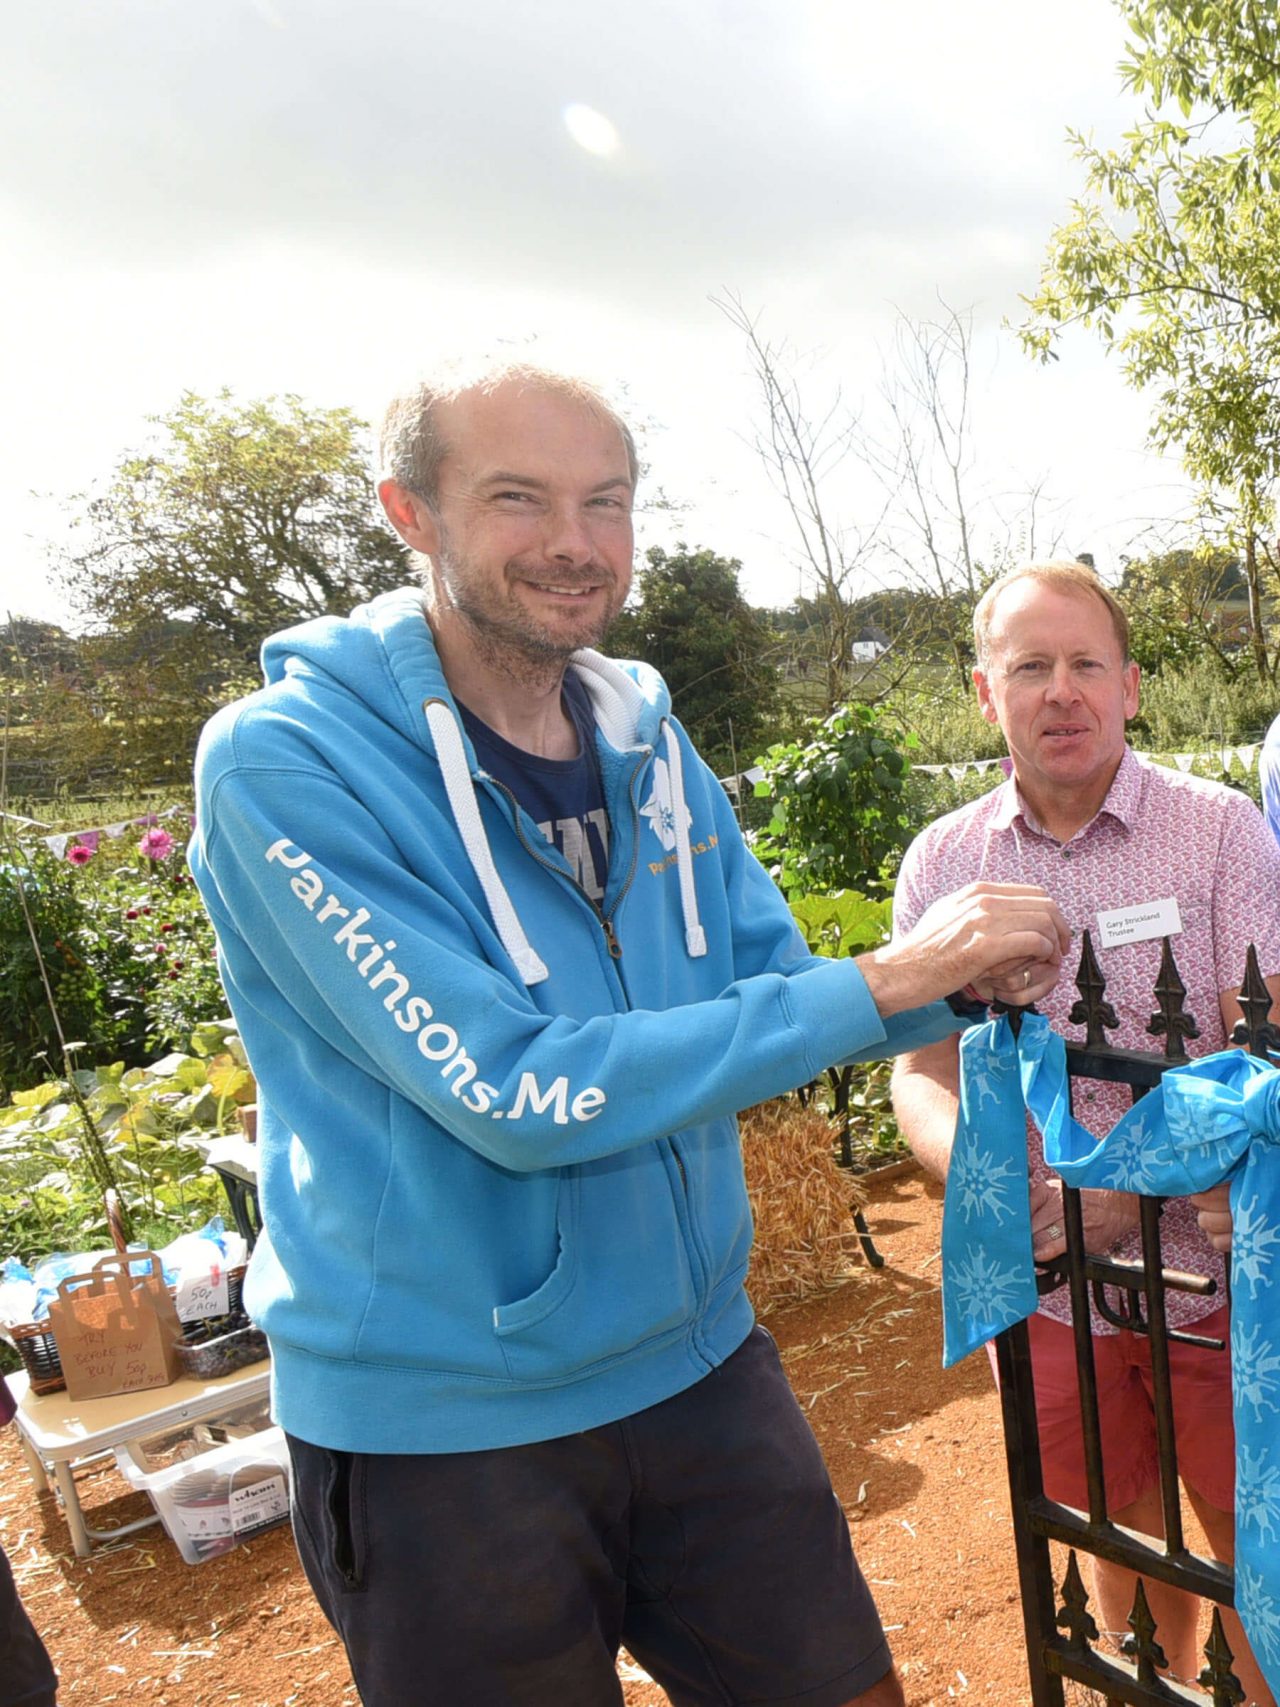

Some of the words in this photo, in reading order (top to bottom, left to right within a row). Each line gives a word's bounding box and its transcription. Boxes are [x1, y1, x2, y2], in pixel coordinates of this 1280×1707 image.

[1106, 921, 1123, 930] Gary
[1125, 912, 1161, 926] Strickland
[1108, 928, 1135, 938] Trustee
[264, 838, 606, 1124] Parkinsons.Me
[80, 1329, 105, 1346] TRY
[73, 1346, 117, 1365] BEFORE
[125, 1343, 143, 1354] YOU
[86, 1361, 116, 1377] BUY
